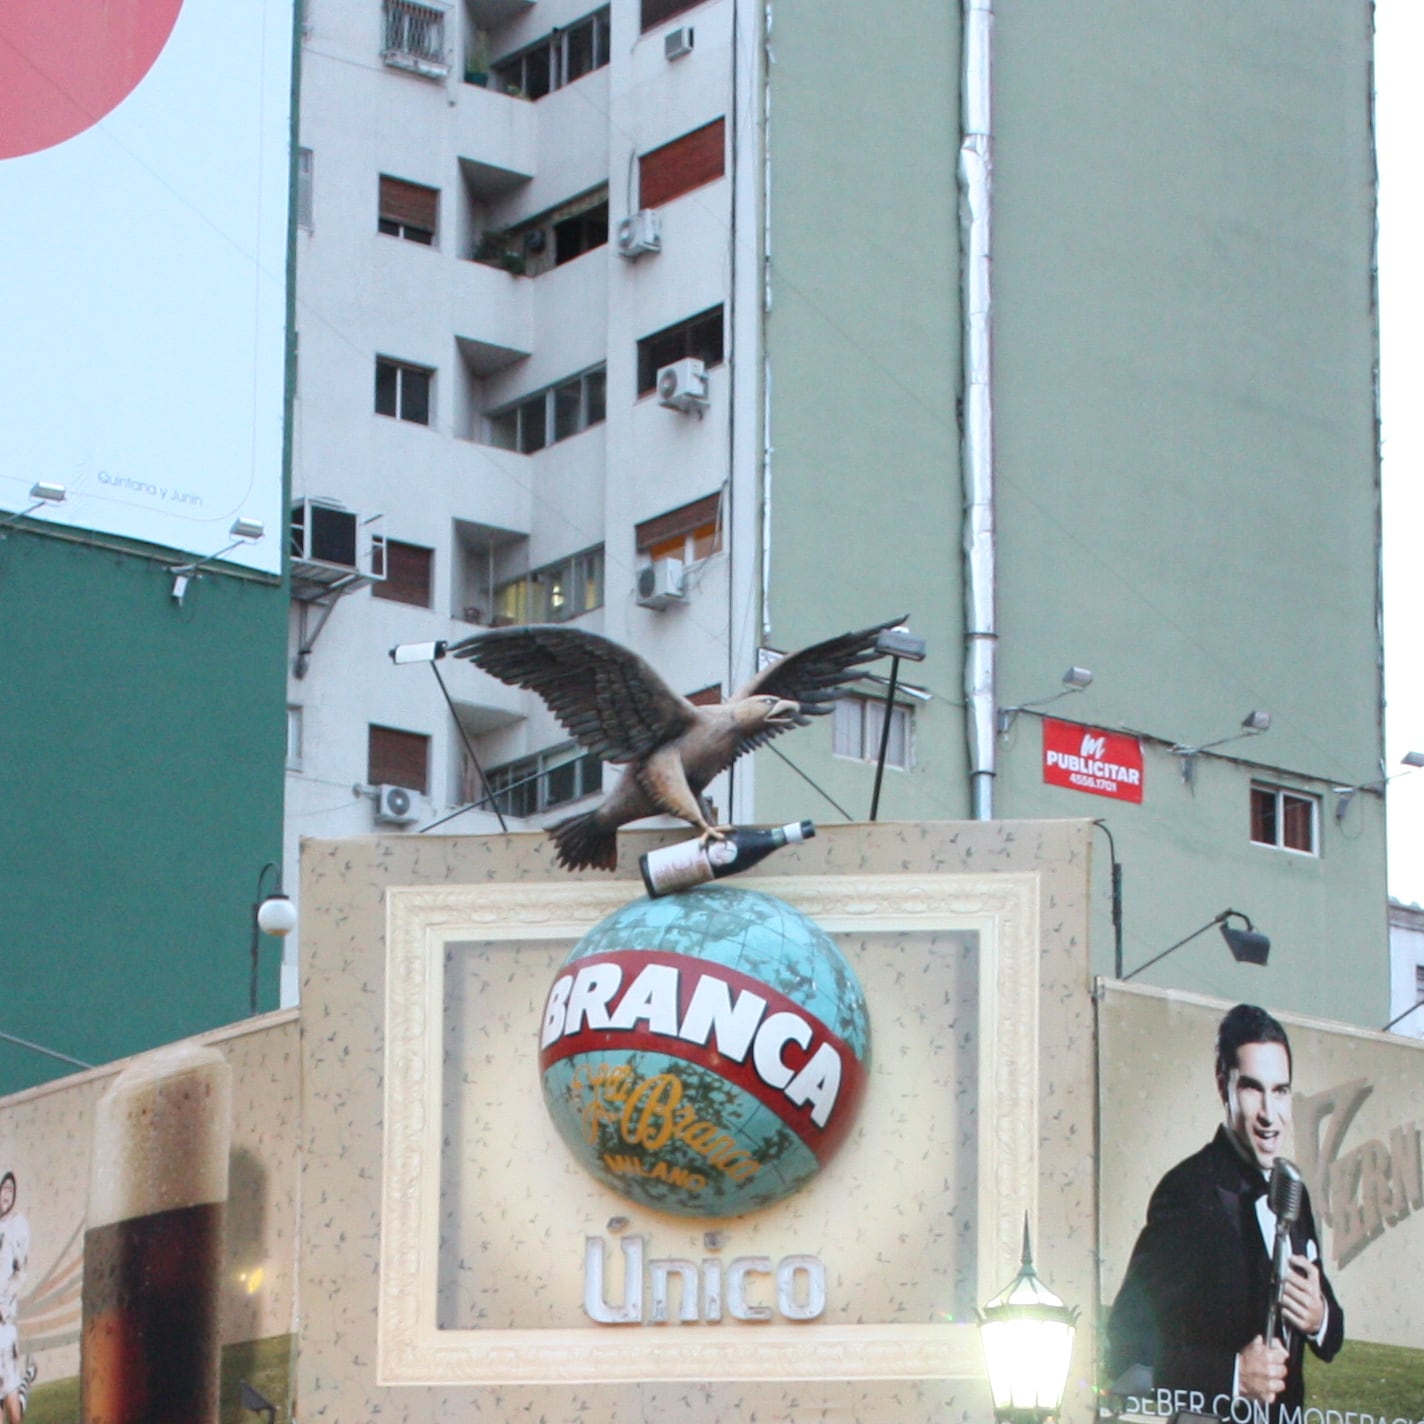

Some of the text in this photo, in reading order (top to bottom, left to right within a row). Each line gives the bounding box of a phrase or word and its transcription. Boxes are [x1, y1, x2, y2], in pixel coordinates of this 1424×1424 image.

[1046, 749, 1140, 786] PUBLICITAR
[541, 962, 843, 1129] BRANCA
[602, 1153, 708, 1192] MILANO
[621, 1073, 762, 1183] Branca
[584, 1216, 827, 1327] Único
